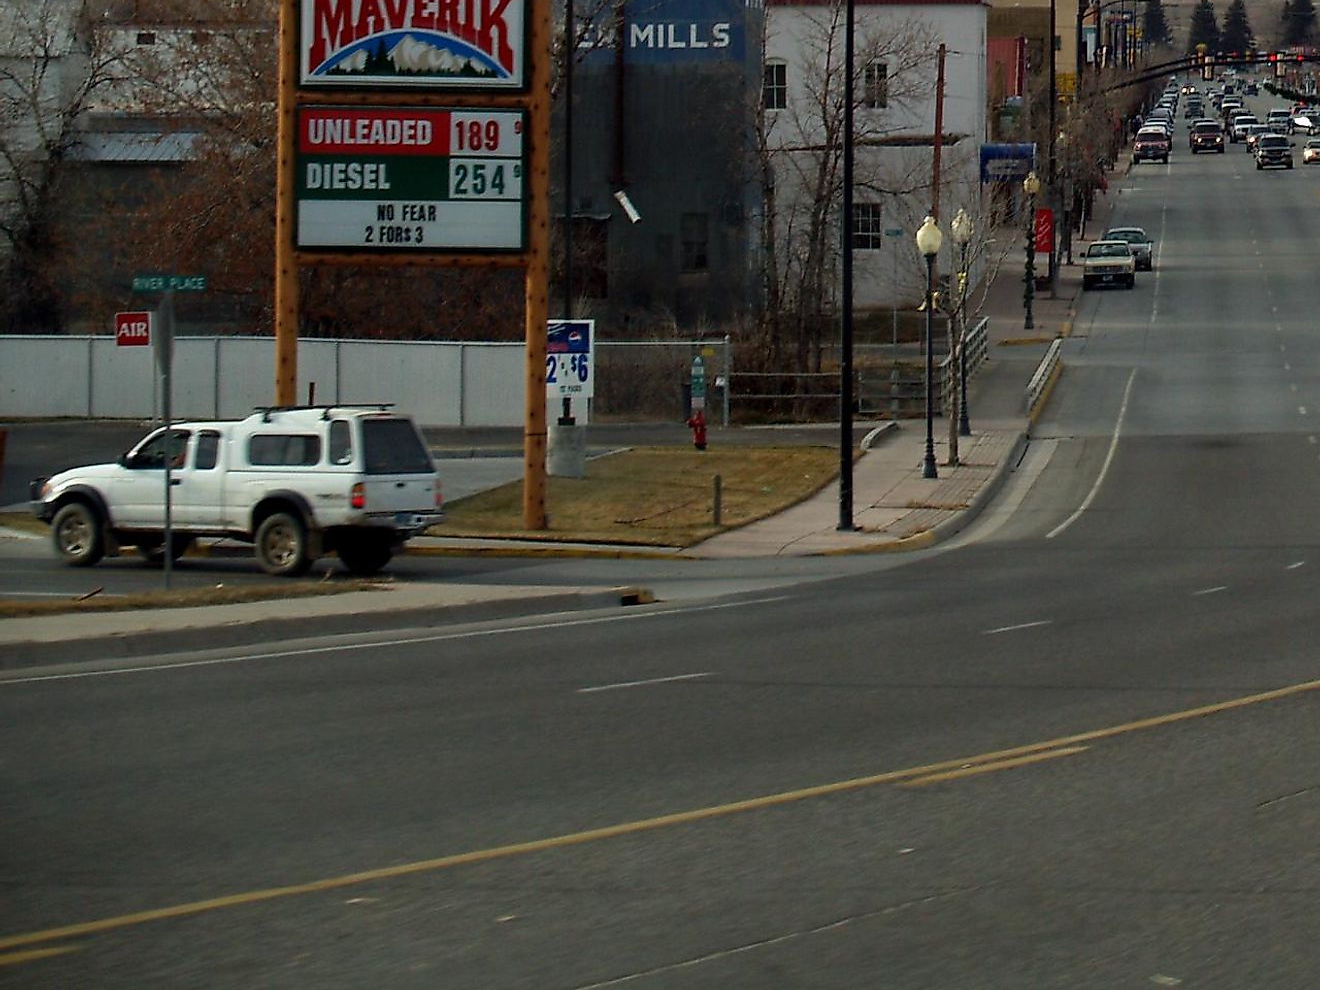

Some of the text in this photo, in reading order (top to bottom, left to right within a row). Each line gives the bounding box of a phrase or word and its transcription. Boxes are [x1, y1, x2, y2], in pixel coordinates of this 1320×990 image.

[630, 23, 731, 49] MILLS
[308, 119, 432, 146] UNLEADED
[455, 120, 499, 151] 189
[306, 162, 391, 190] DIESEL
[454, 164, 505, 195] 254
[377, 204, 436, 222] NO FEAR
[365, 225, 374, 242] 2
[118, 321, 148, 337] AIR
